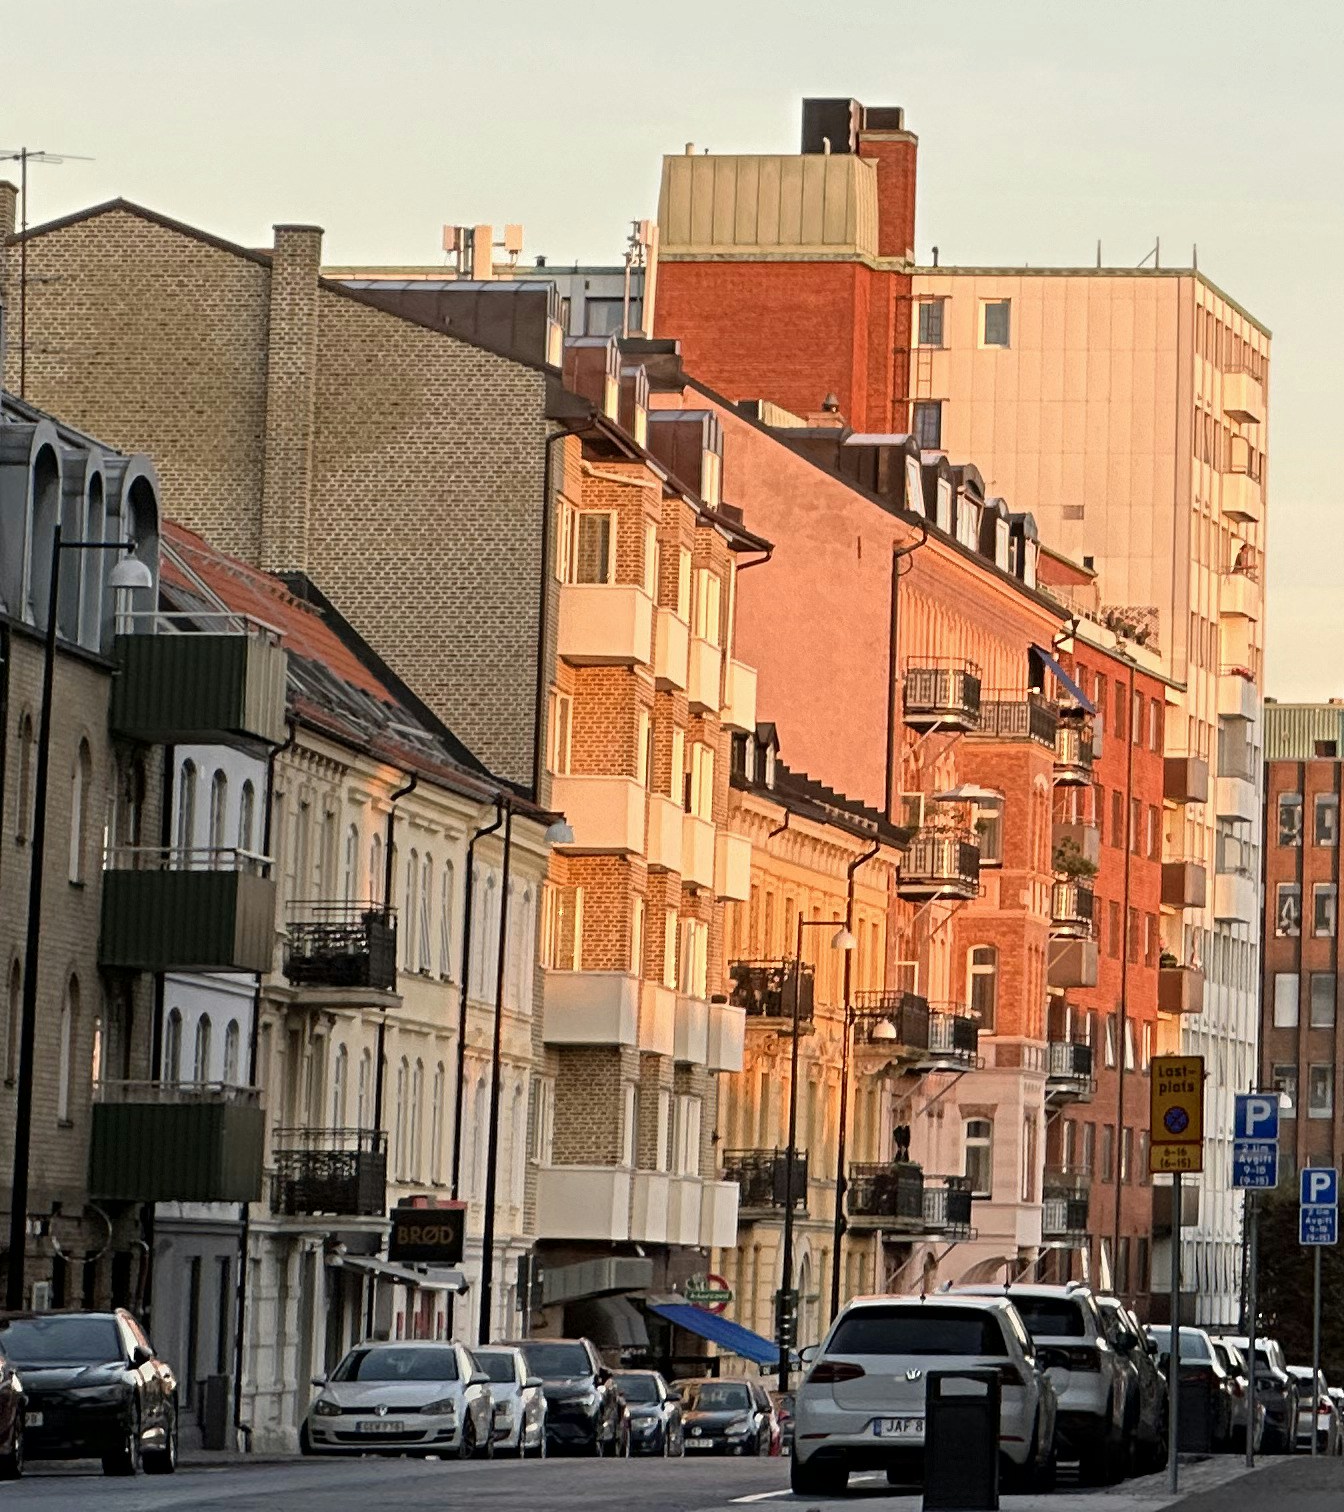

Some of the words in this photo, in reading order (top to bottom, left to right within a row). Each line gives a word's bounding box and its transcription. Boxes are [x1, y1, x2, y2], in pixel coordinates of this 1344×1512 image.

[1158, 1065, 1197, 1078] Last-
[1158, 1081, 1195, 1096] plats
[1245, 1098, 1272, 1137] P
[1309, 1172, 1331, 1203] P
[397, 1226, 455, 1245] BRØD
[886, 1419, 910, 1433] JAF
